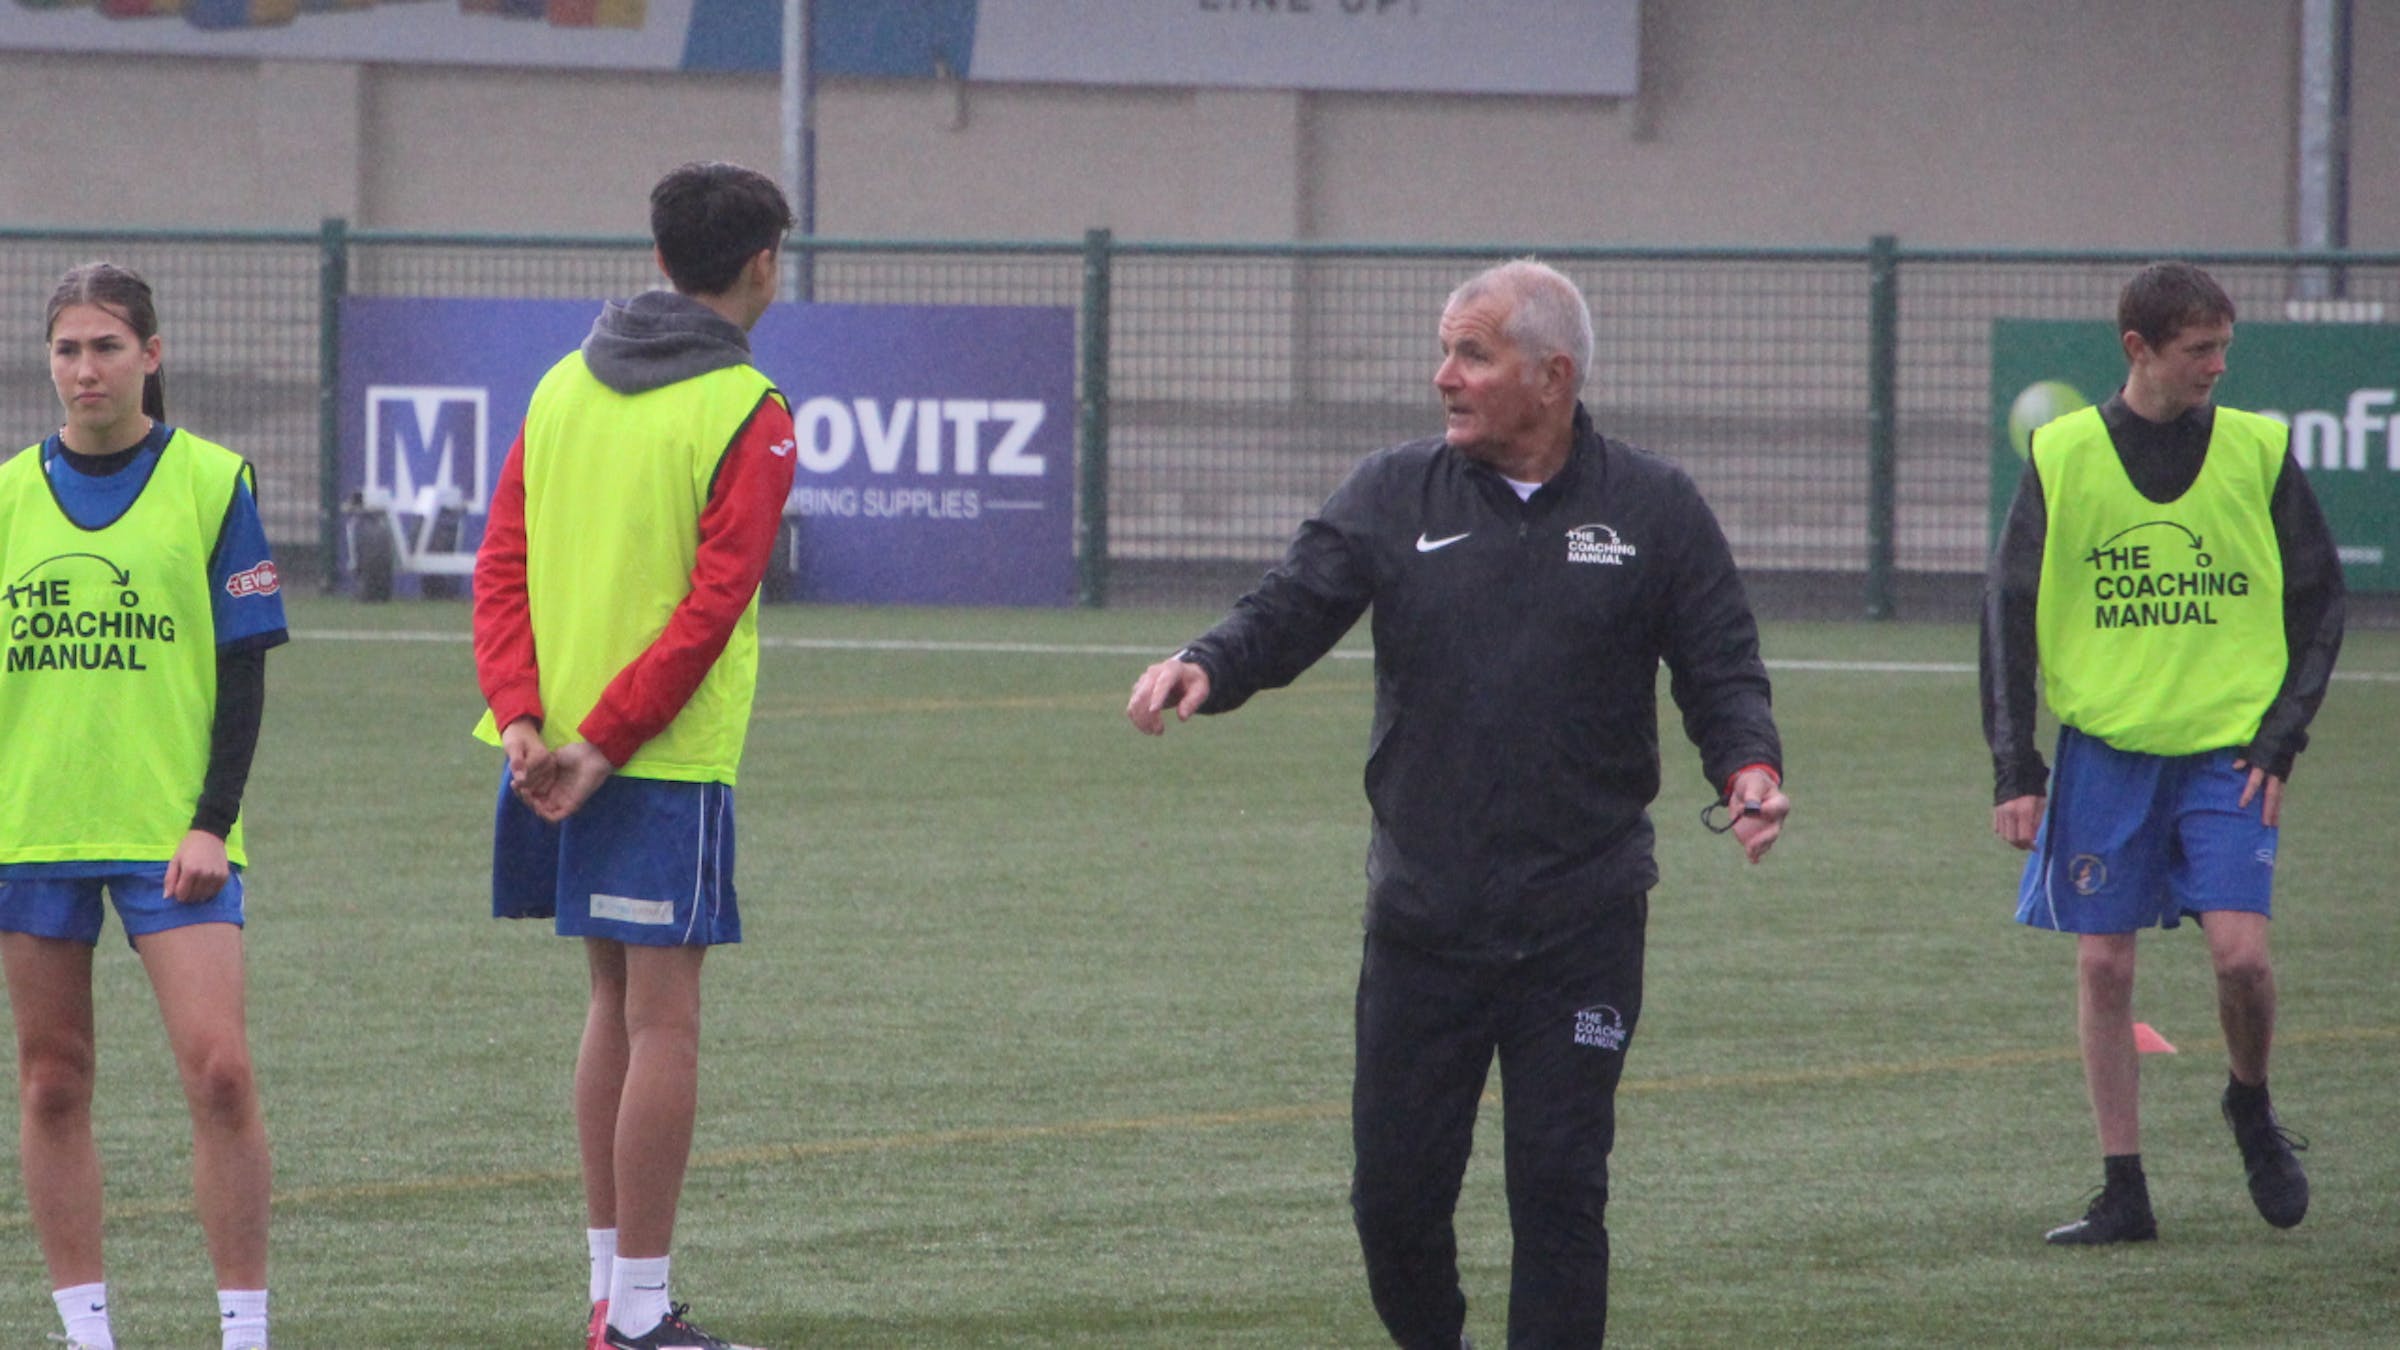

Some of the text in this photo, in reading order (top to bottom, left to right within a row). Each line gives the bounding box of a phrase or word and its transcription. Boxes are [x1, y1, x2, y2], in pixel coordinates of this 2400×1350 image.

[863, 488, 981, 519] SUPPLIES
[1567, 551, 1623, 566] MANUAL
[1568, 541, 1636, 557] COACHING
[2085, 546, 2151, 570] THE
[2, 580, 70, 609] THE
[2095, 571, 2249, 600] COACHING
[11, 612, 176, 642] COACHING
[2096, 601, 2218, 628] MANUAL
[7, 645, 147, 673] MANUAL
